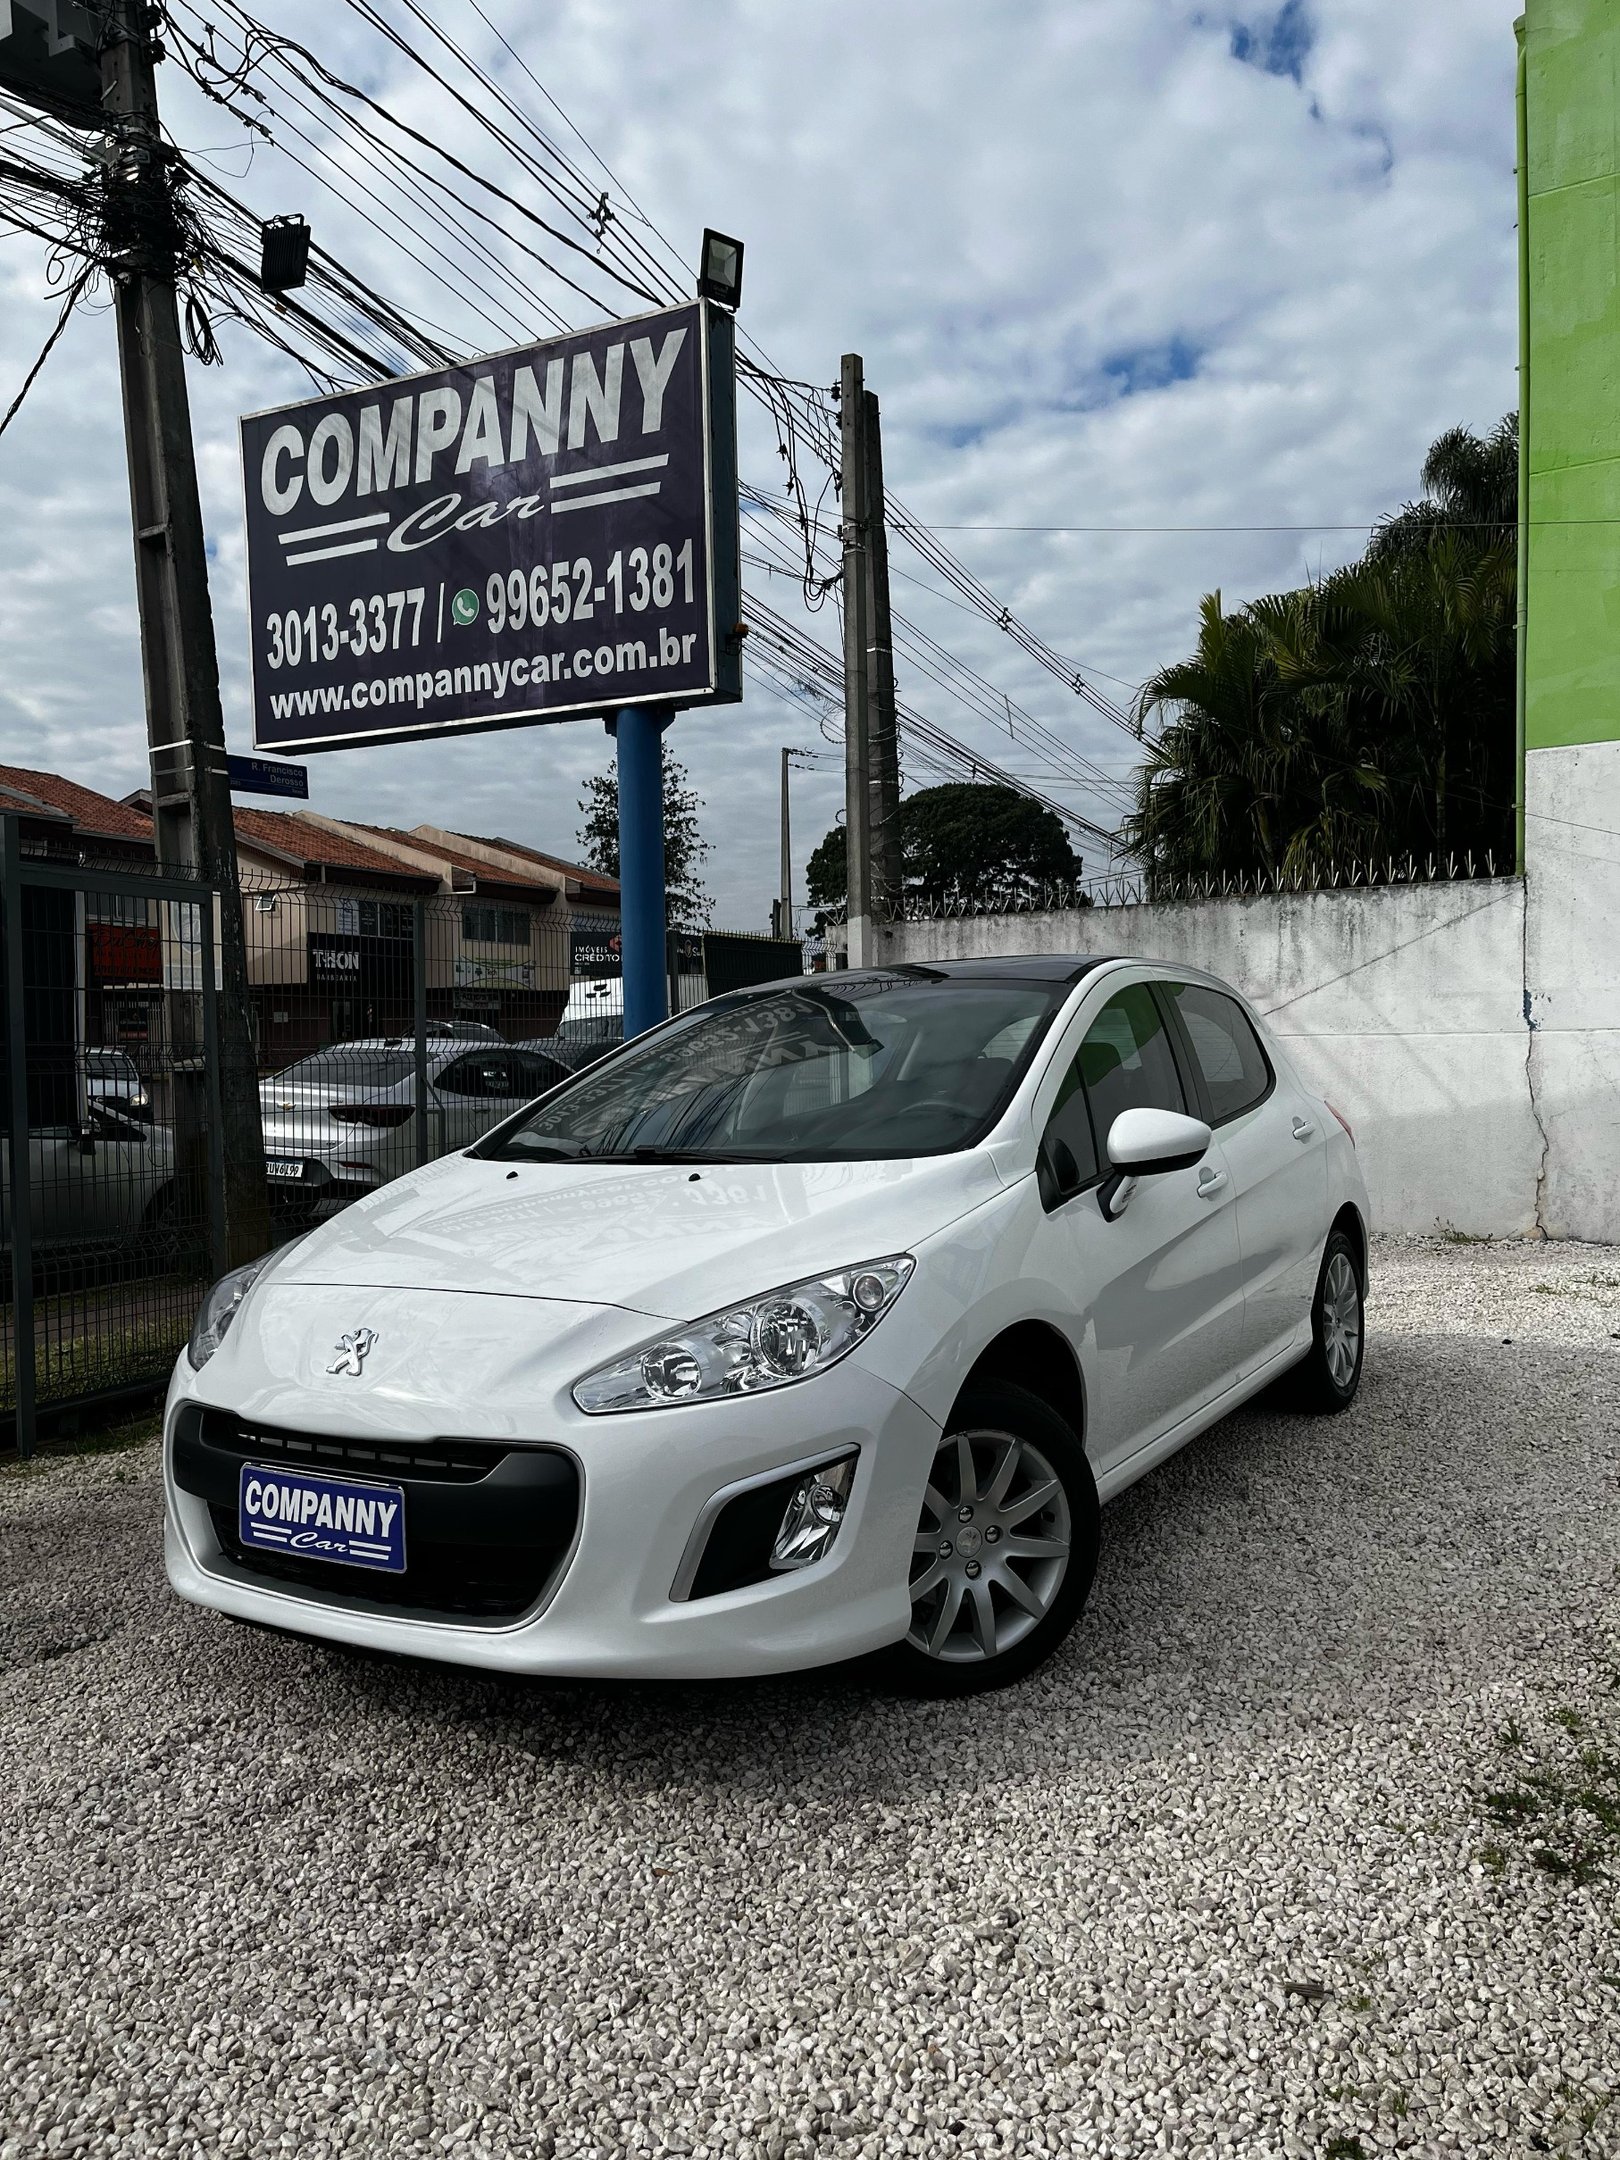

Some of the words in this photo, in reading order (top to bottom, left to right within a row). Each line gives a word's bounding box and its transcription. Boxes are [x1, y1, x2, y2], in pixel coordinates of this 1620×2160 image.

[261, 327, 688, 516] COMPANNY
[386, 493, 545, 552] Car
[266, 588, 425, 670] 3013-3377
[486, 537, 695, 635] 99652-1381
[270, 627, 697, 720] www.compannycar.com.br
[251, 761, 261, 771] R.
[263, 763, 304, 777] Francisco
[270, 774, 304, 787] Derosso
[574, 953, 620, 962] CRÉDTO
[575, 945, 608, 954] IMÓVEIS
[245, 1480, 398, 1538] COMPANNY
[290, 1531, 349, 1553] Car
